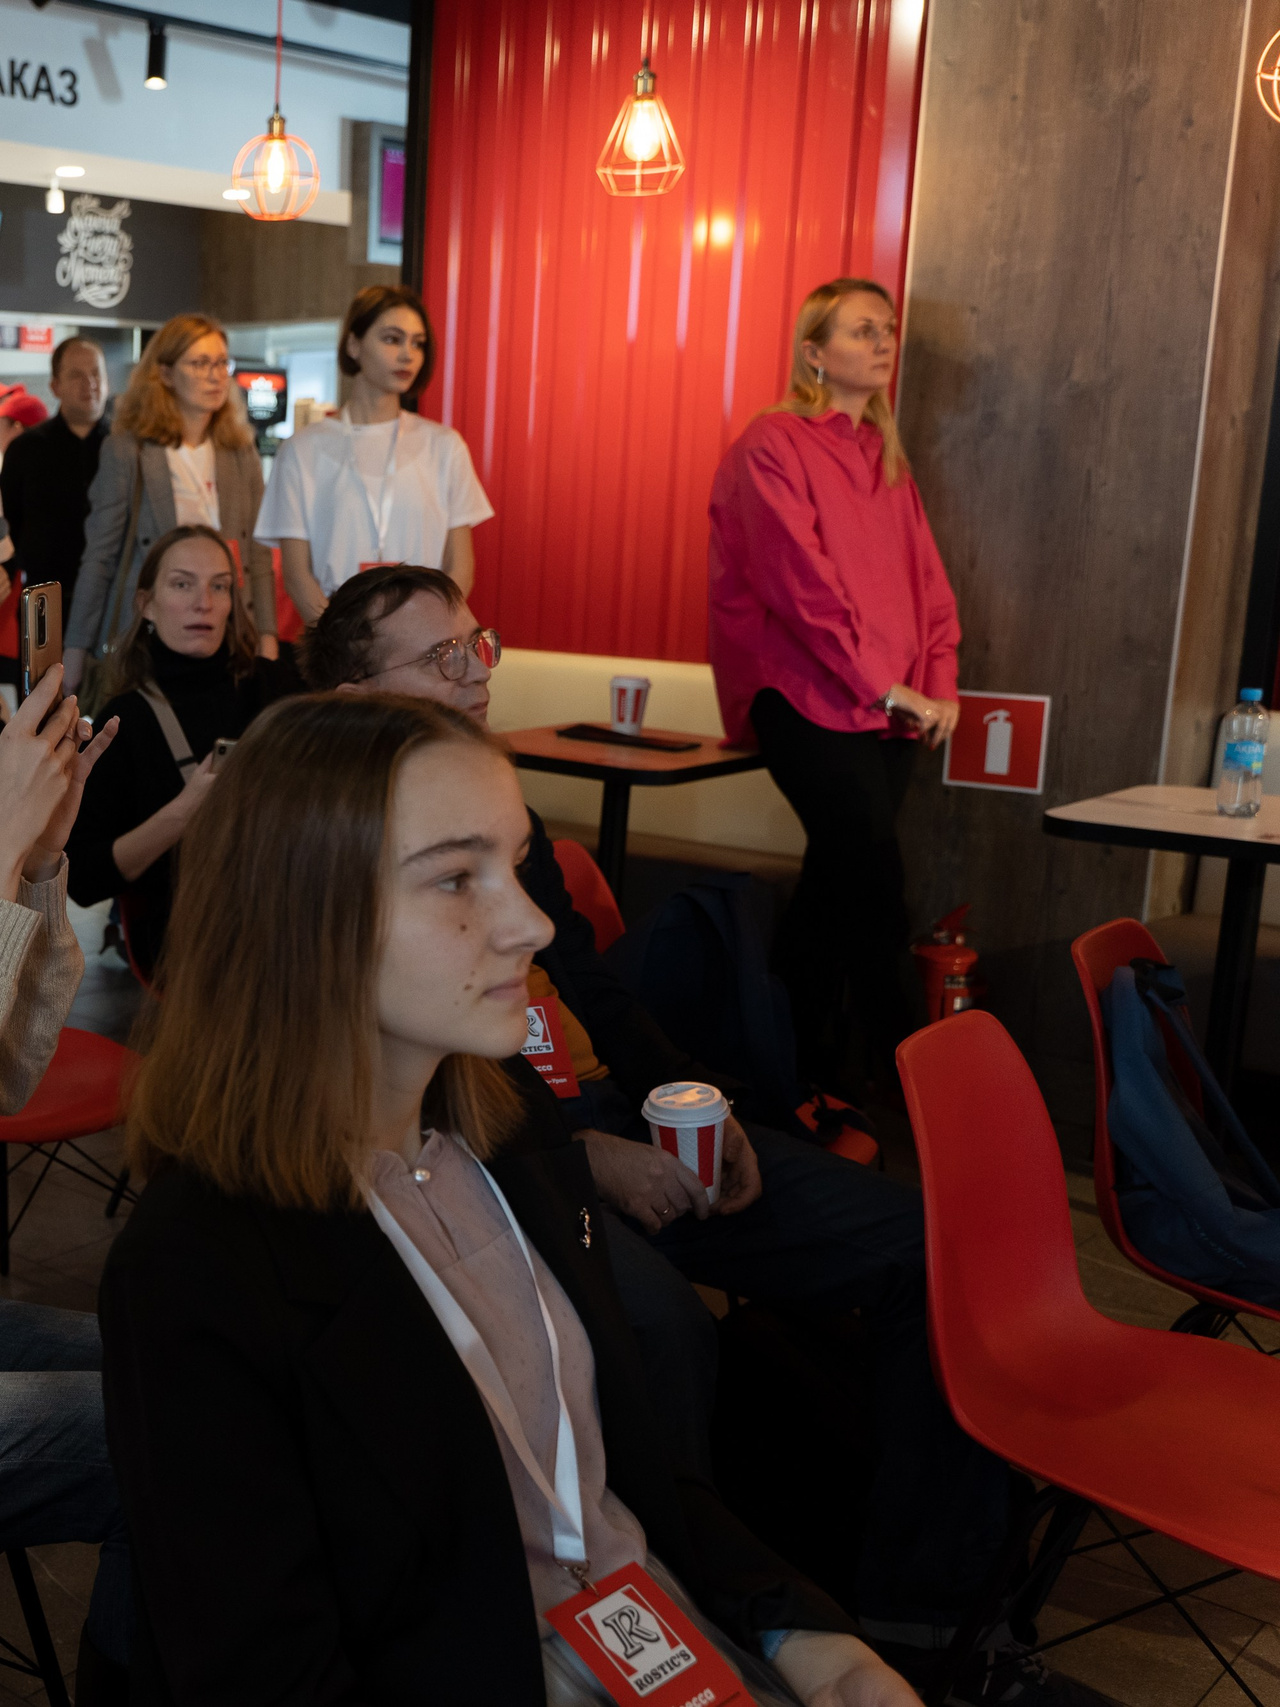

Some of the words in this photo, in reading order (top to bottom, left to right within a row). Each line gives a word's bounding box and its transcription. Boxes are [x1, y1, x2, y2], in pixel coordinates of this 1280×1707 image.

[521, 1044, 552, 1053] STIC'S
[602, 1605, 660, 1659] R
[634, 1649, 691, 1691] ROSTIC'S
